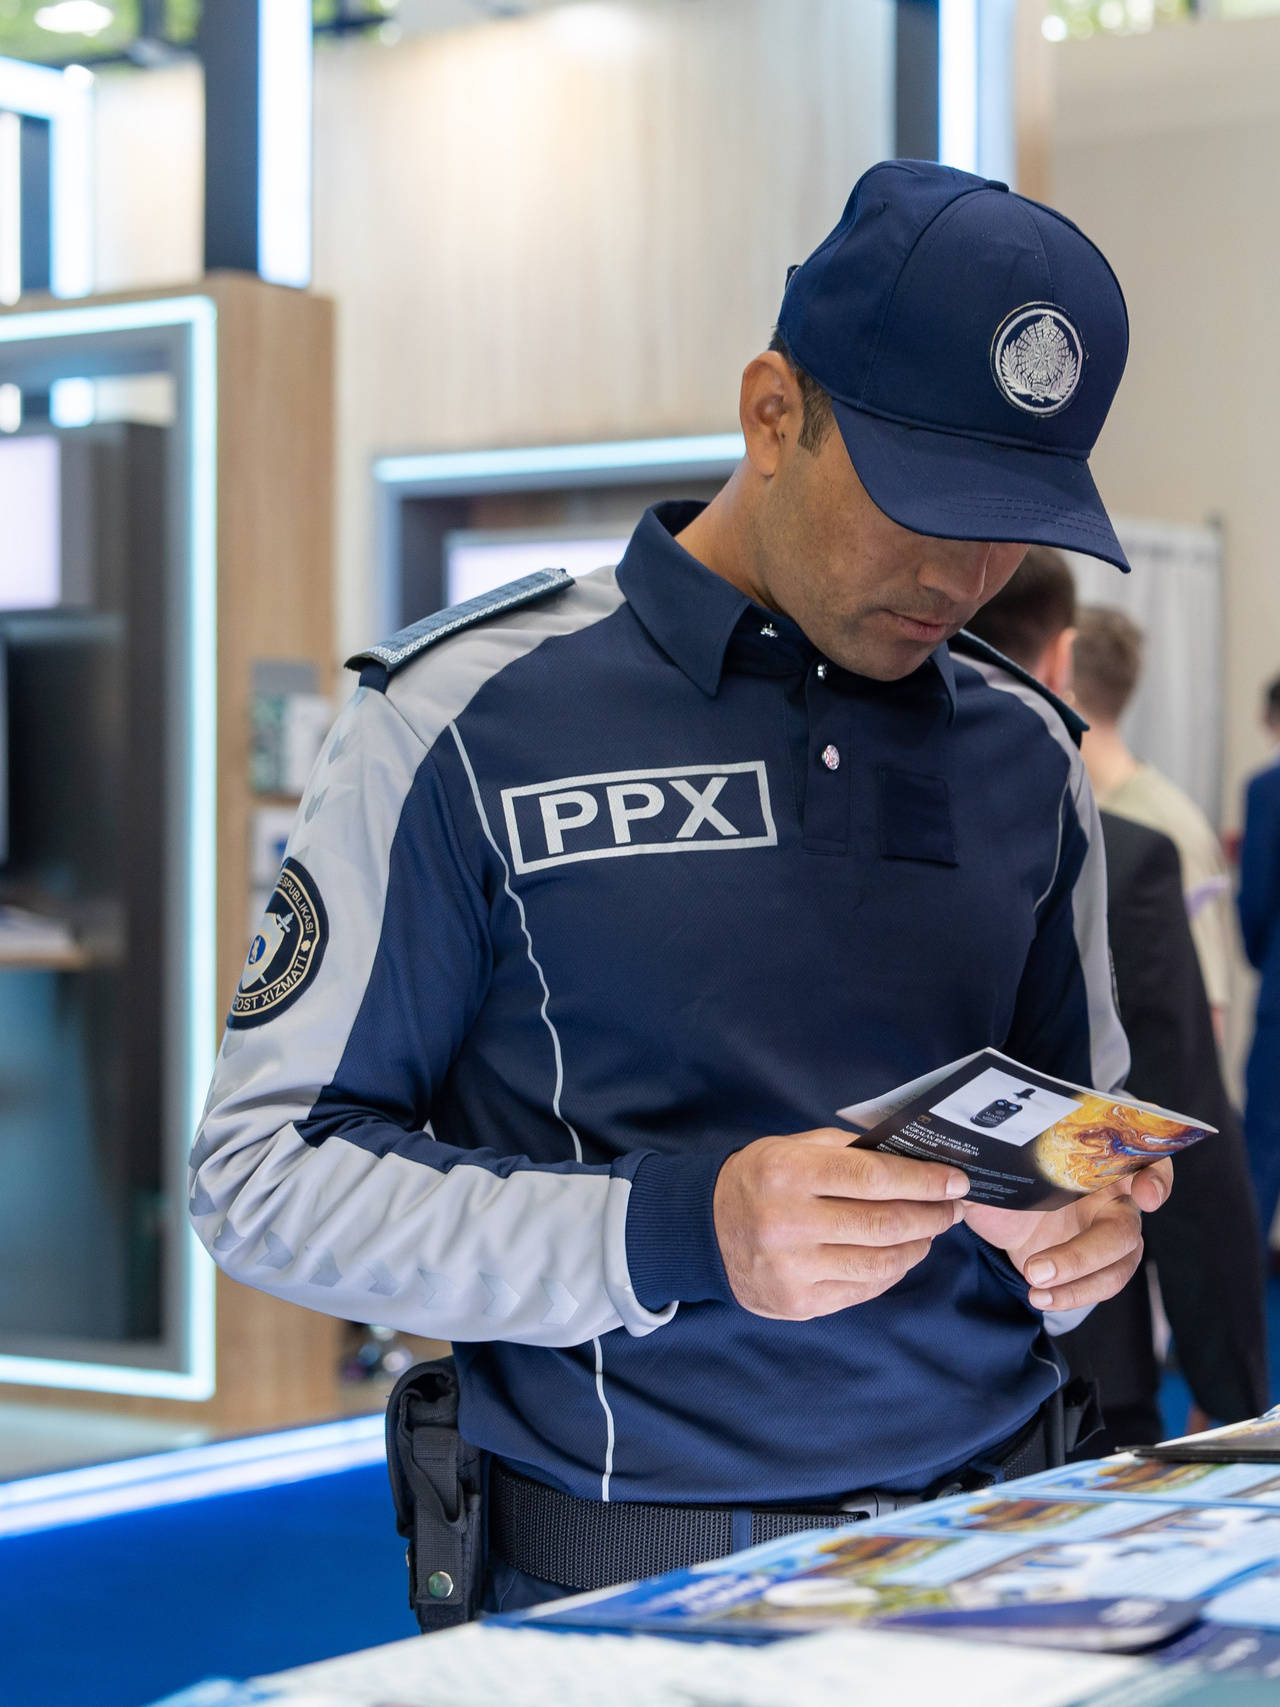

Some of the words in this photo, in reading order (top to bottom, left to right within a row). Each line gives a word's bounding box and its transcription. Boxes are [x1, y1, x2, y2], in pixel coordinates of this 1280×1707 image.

[539, 776, 740, 856] PPX
[277, 874, 315, 934] ESPUBLIKASI
[262, 955, 307, 1006] XIZMATI
[900, 1128, 920, 1141] NIGHT
